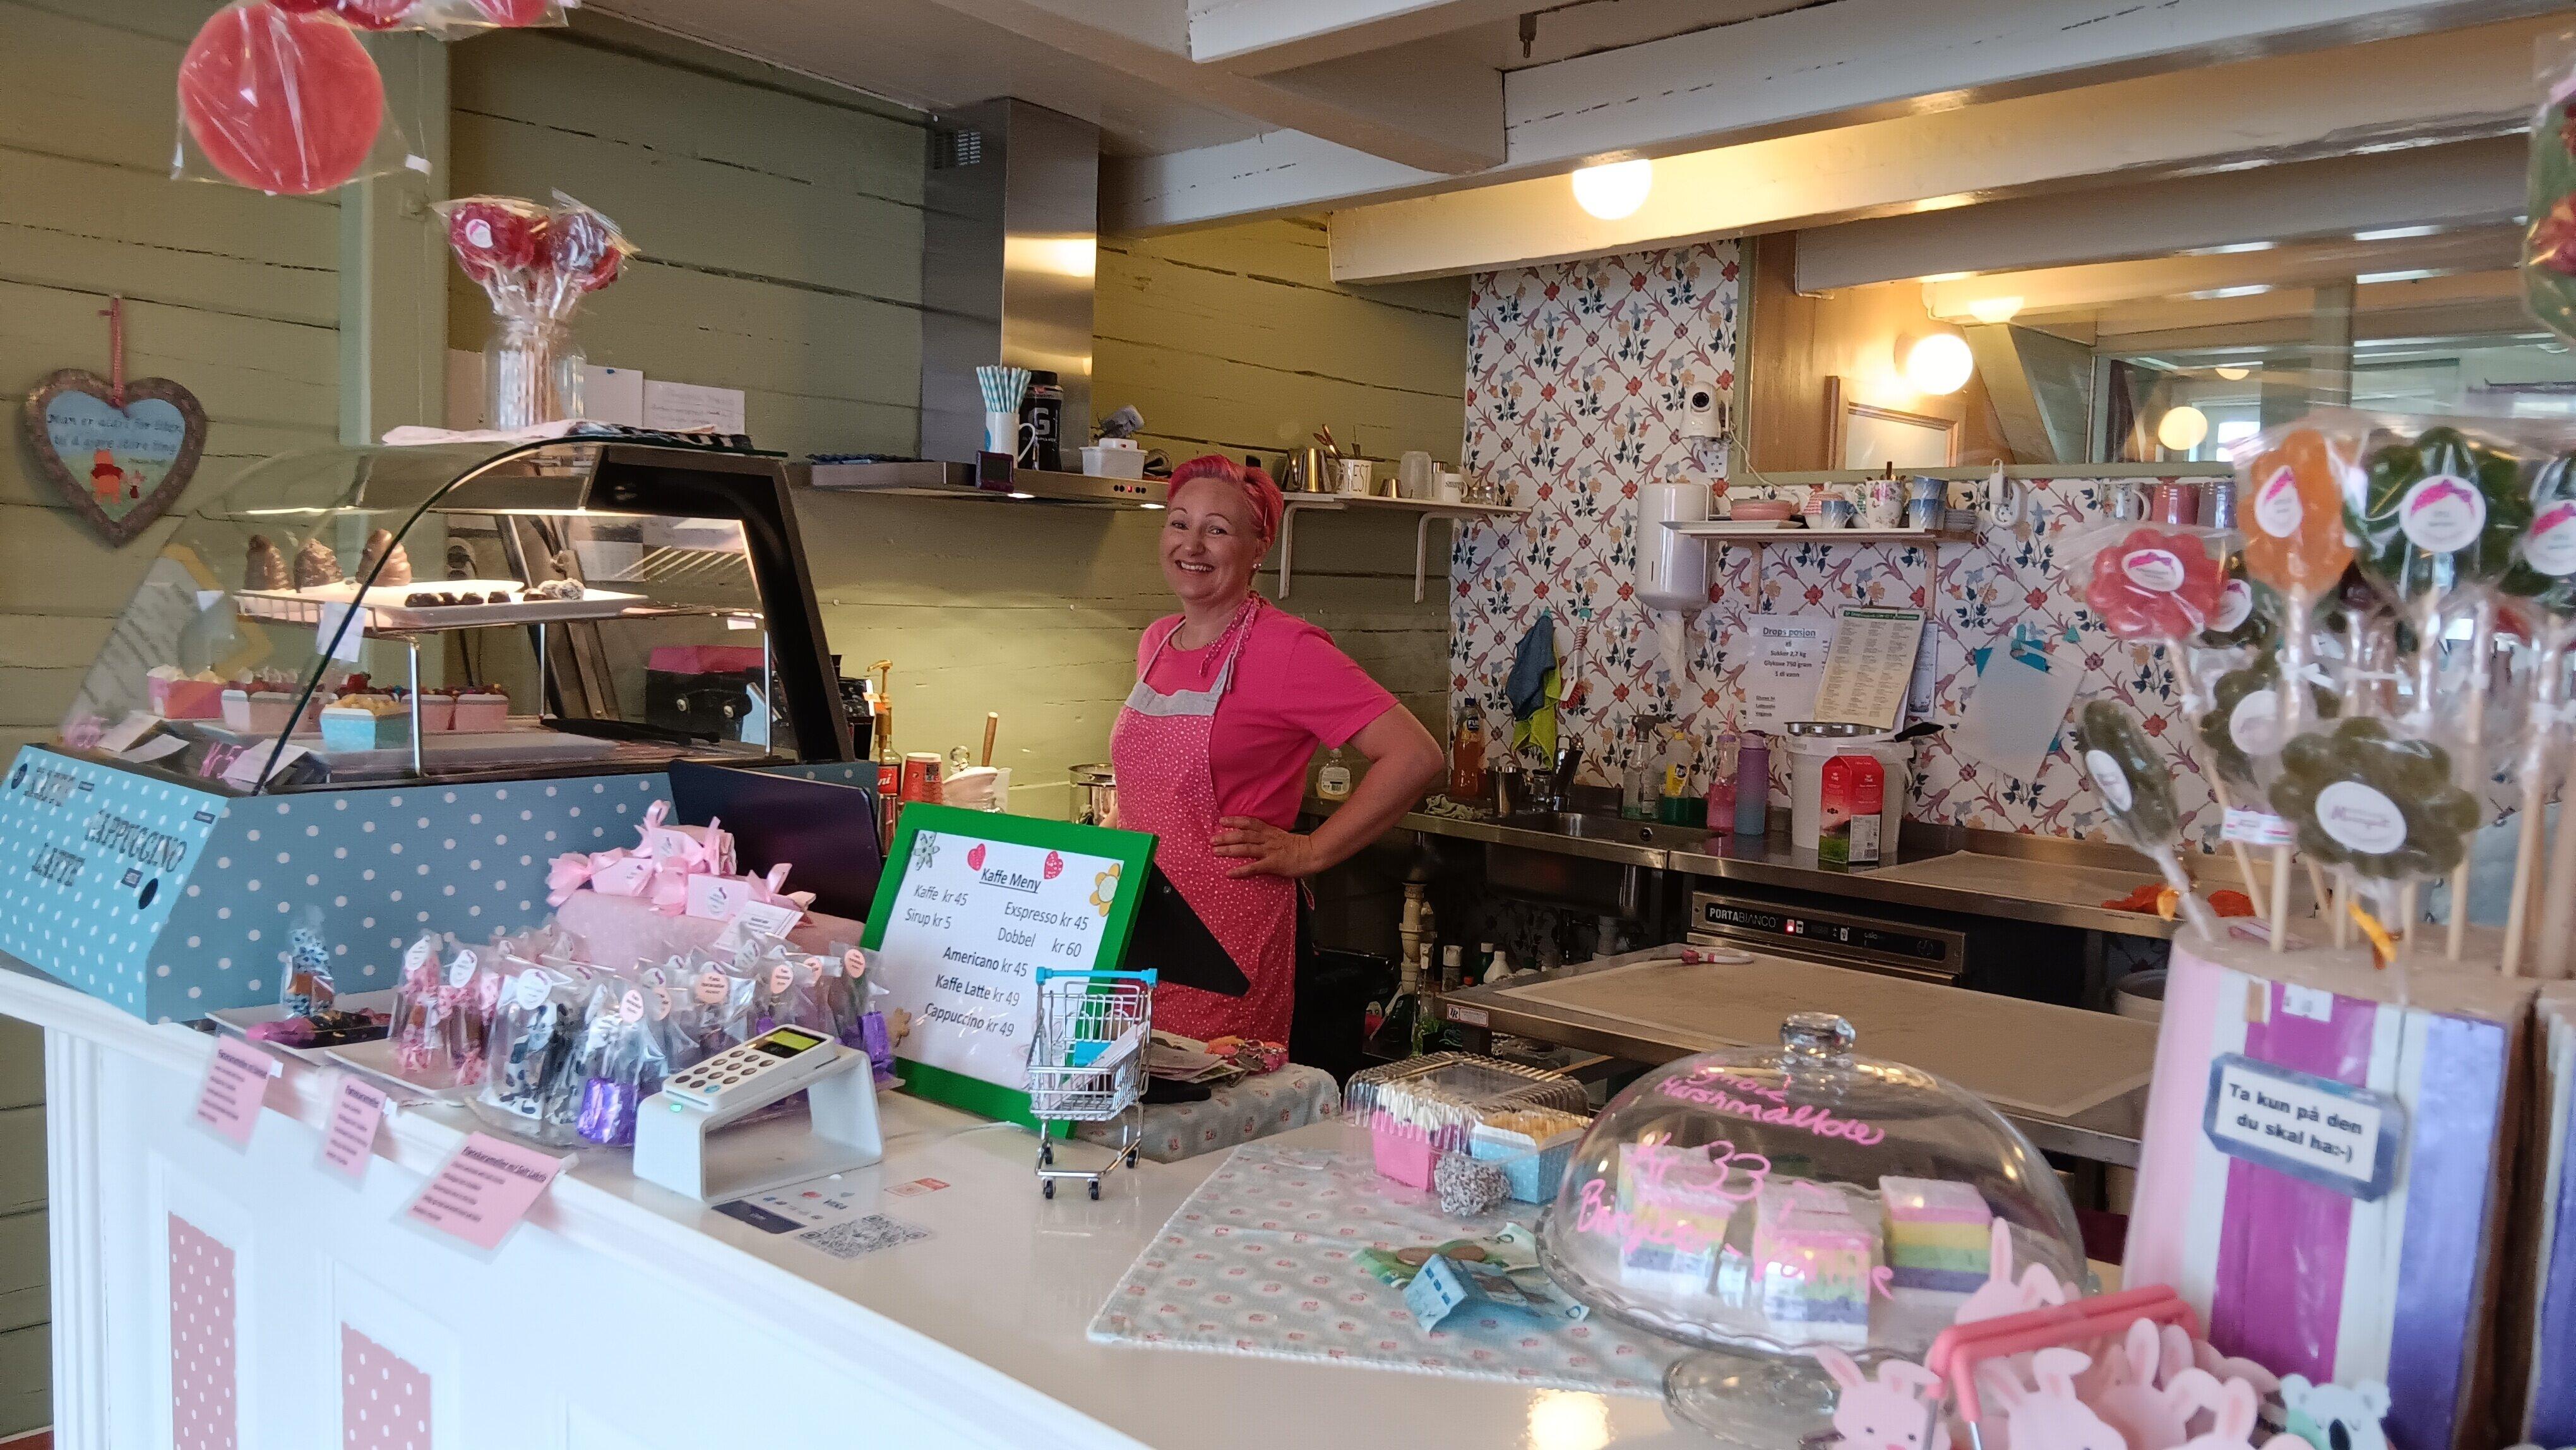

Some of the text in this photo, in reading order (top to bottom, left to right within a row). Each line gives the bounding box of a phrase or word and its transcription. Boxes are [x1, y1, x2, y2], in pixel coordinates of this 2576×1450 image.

[914, 884, 969, 906] Kaffe kr 45
[981, 868, 1041, 893] Kaffe Meny
[905, 908, 953, 929] Sirup kr 5
[1005, 901, 1089, 930] Exspresso kr 45
[1710, 907, 1776, 928] PORTABIANCO
[998, 927, 1082, 957] Dobbel kr 60
[943, 947, 1028, 977] Americano kr 45
[936, 974, 1020, 1006] Kaffe Latte kr 49
[925, 1002, 1015, 1036] Cappuccino kr 49
[2229, 1082, 2362, 1134] Ta kun på den
[2236, 1113, 2258, 1130] du
[2265, 1123, 2305, 1144] skal
